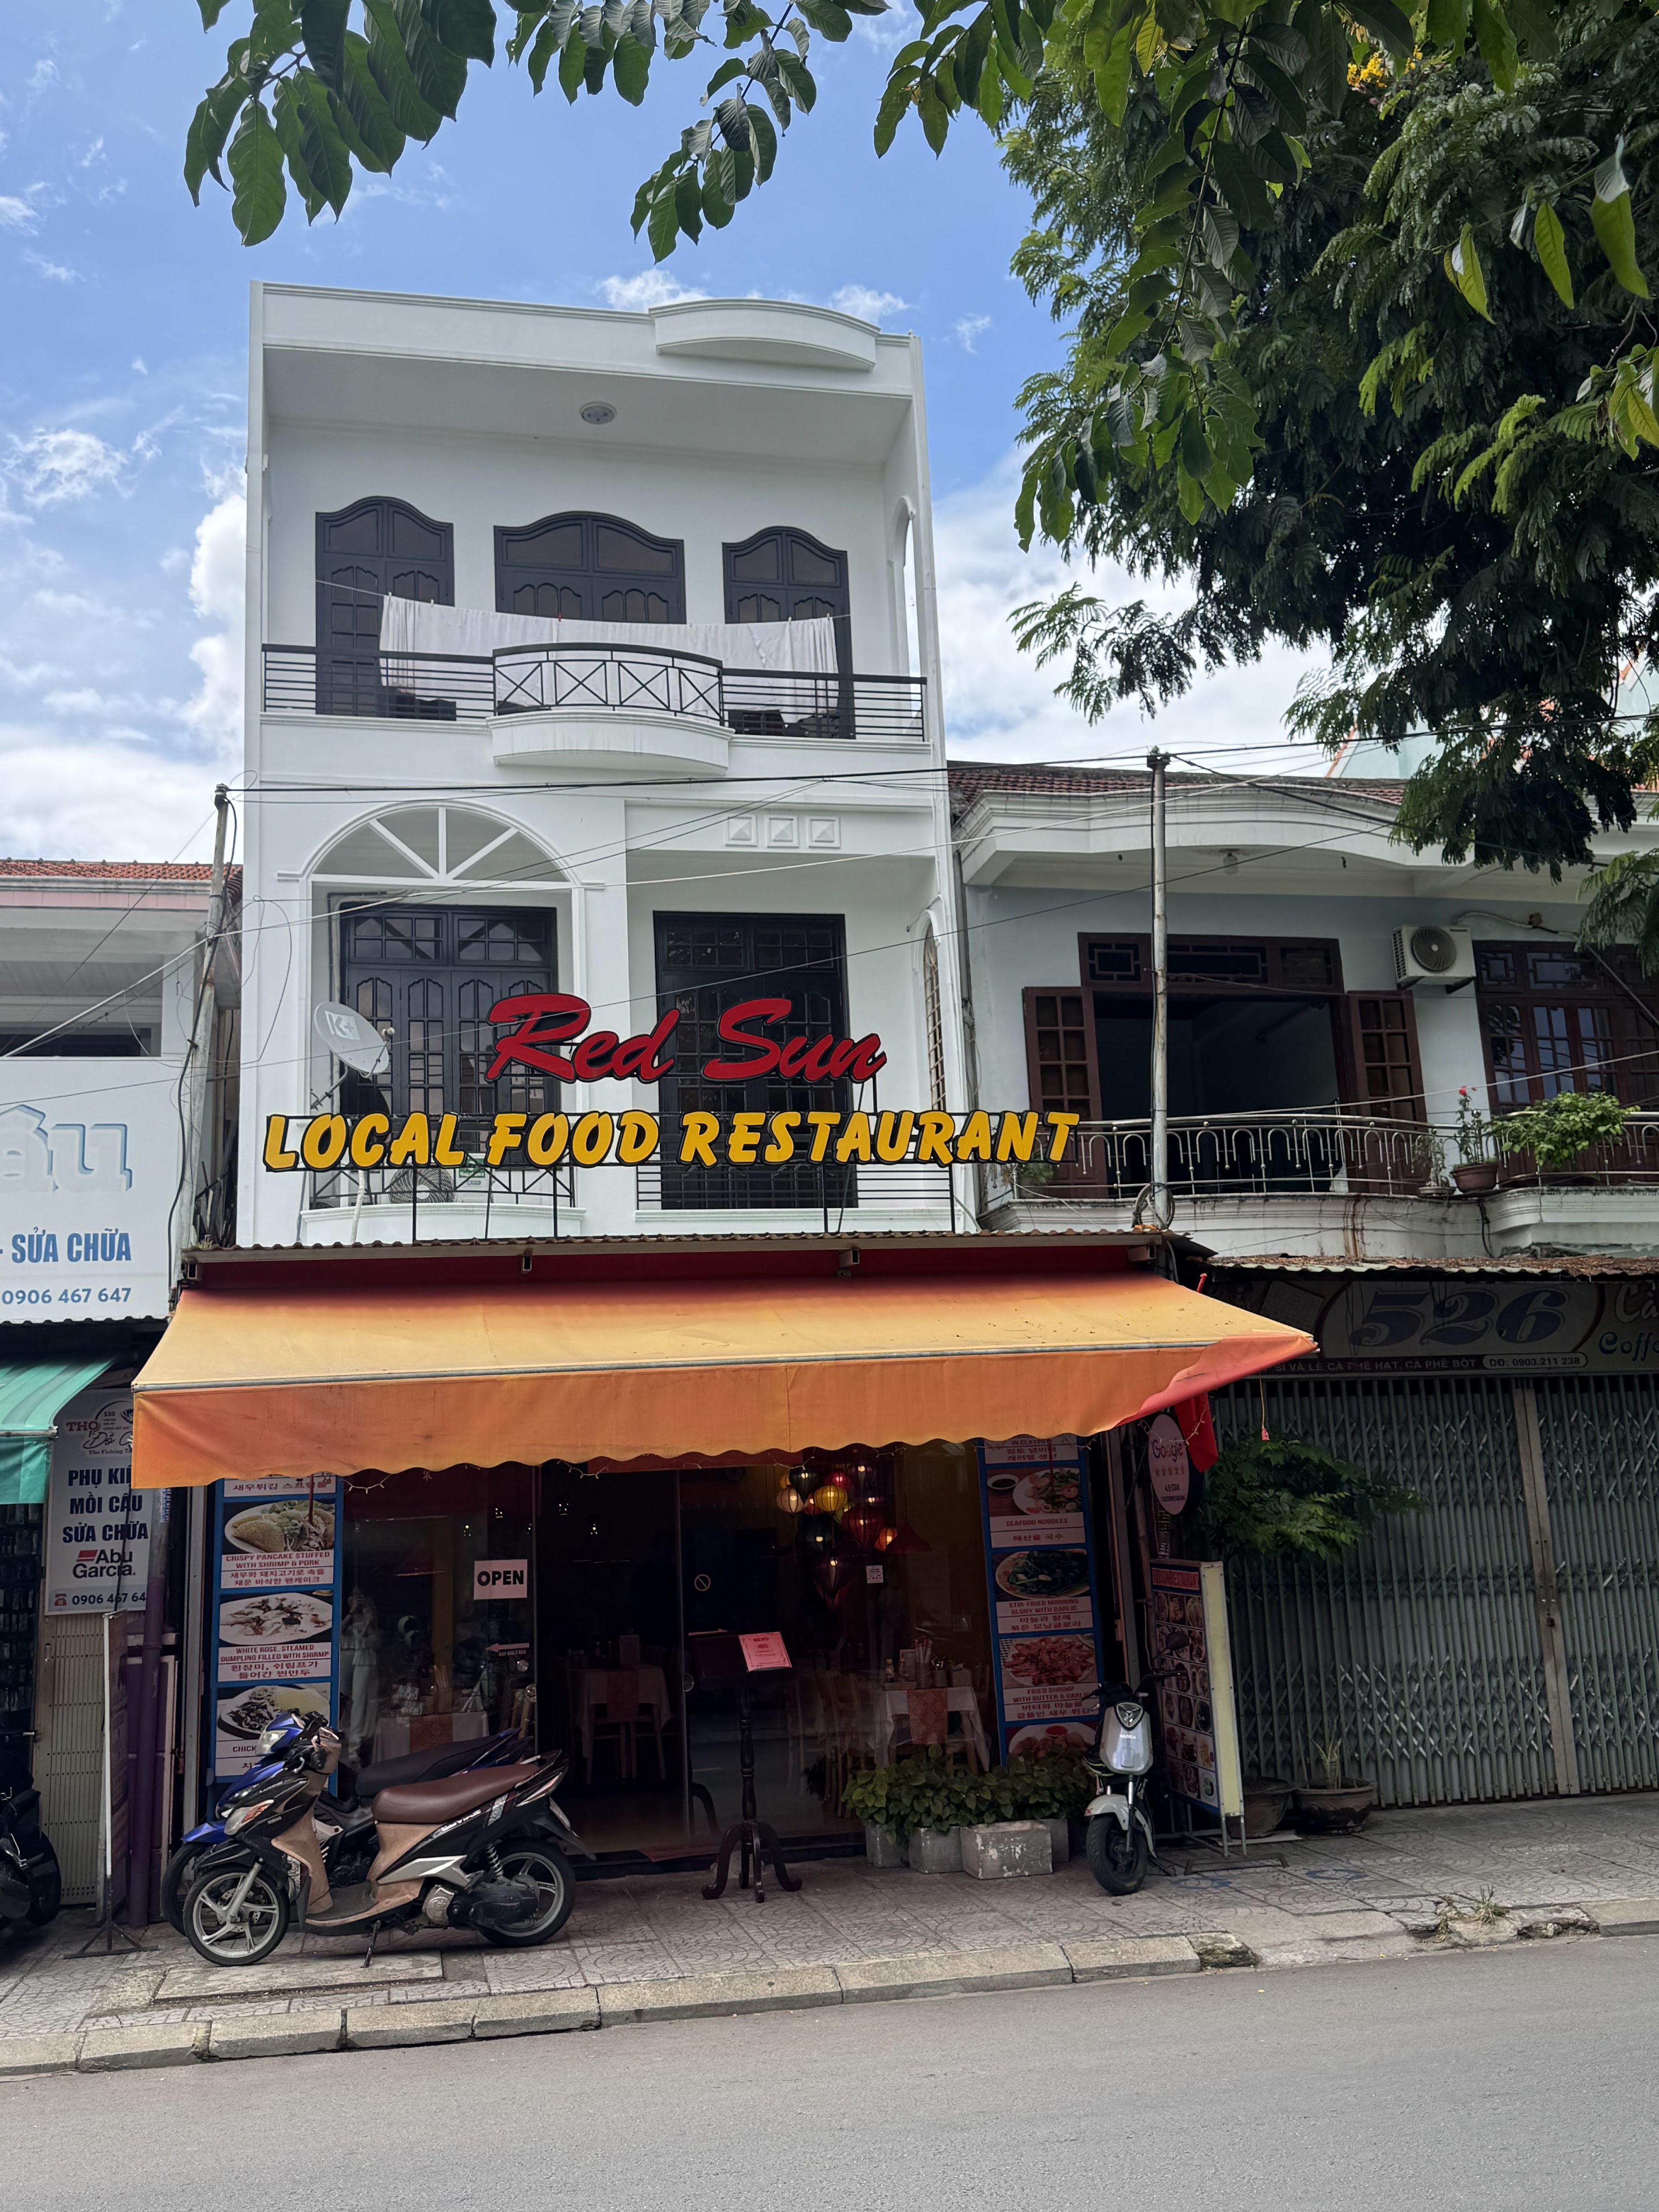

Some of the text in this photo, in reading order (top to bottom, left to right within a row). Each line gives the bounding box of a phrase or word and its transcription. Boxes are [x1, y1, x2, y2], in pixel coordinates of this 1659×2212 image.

[485, 992, 888, 1084] Red Sun
[263, 1109, 1082, 1171] LOCAL FOOD RESTAURANT
[12, 1226, 131, 1263] SỬA CHỮA
[2, 1288, 131, 1305] 0906 467 647
[1348, 1288, 1568, 1347] 526
[68, 1469, 102, 1488] PHỤ
[70, 1492, 102, 1514] MỒI
[109, 1493, 142, 1513] CÂU
[63, 1521, 148, 1543] SỬA CHỮA
[95, 1549, 133, 1564] Abu
[477, 1570, 524, 1586] OPEN
[72, 1592, 147, 1605] 0906 467 64
